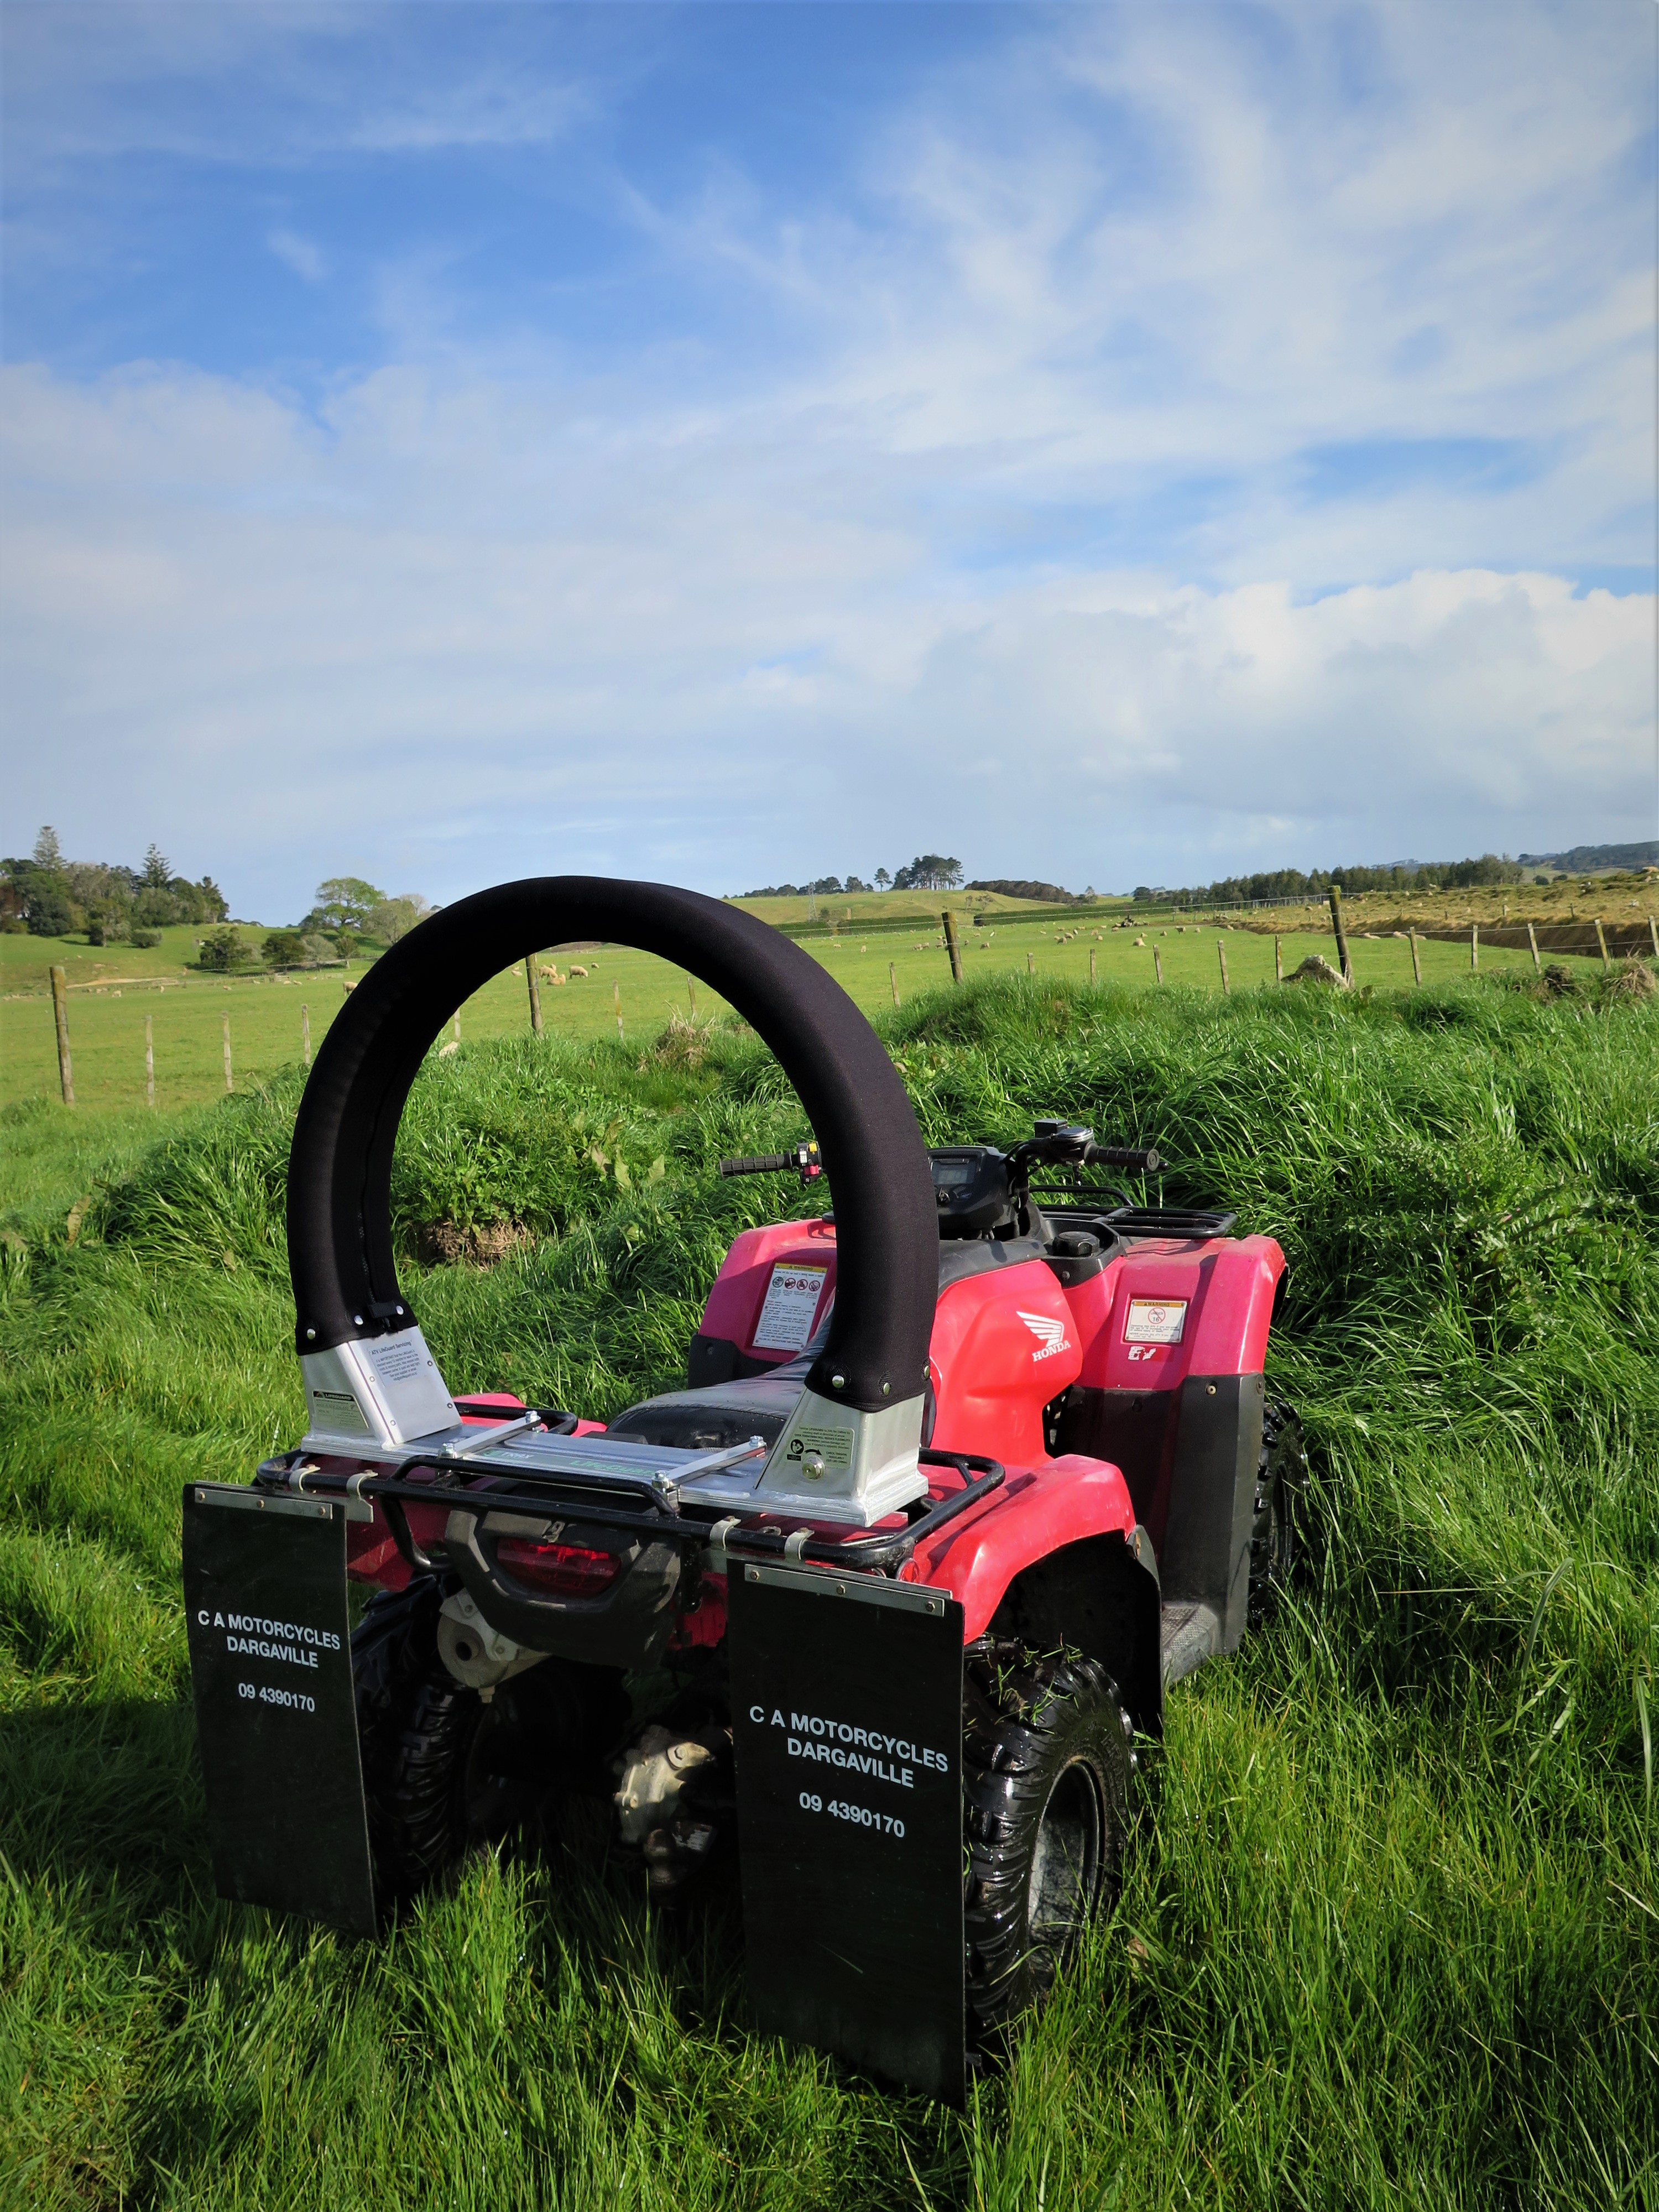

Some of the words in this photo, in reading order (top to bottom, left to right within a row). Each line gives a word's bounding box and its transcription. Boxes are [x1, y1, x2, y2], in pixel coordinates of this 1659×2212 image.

[1032, 1340, 1071, 1363] HONDA
[569, 1460, 656, 1476] LifeGuar
[197, 1610, 210, 1625] C
[213, 1612, 226, 1628] A
[227, 1614, 341, 1650] MOTORCYCLES
[227, 1635, 319, 1668] DARGAVILLE
[238, 1683, 255, 1699] 09
[259, 1687, 315, 1712] 4390170
[749, 1705, 764, 1723] C
[770, 1709, 786, 1728] A
[791, 1712, 948, 1772] MOTORCYCLES
[787, 1737, 914, 1788] DARGAVILLE
[799, 1792, 822, 1812] 09
[827, 1800, 905, 1838] 4390170
